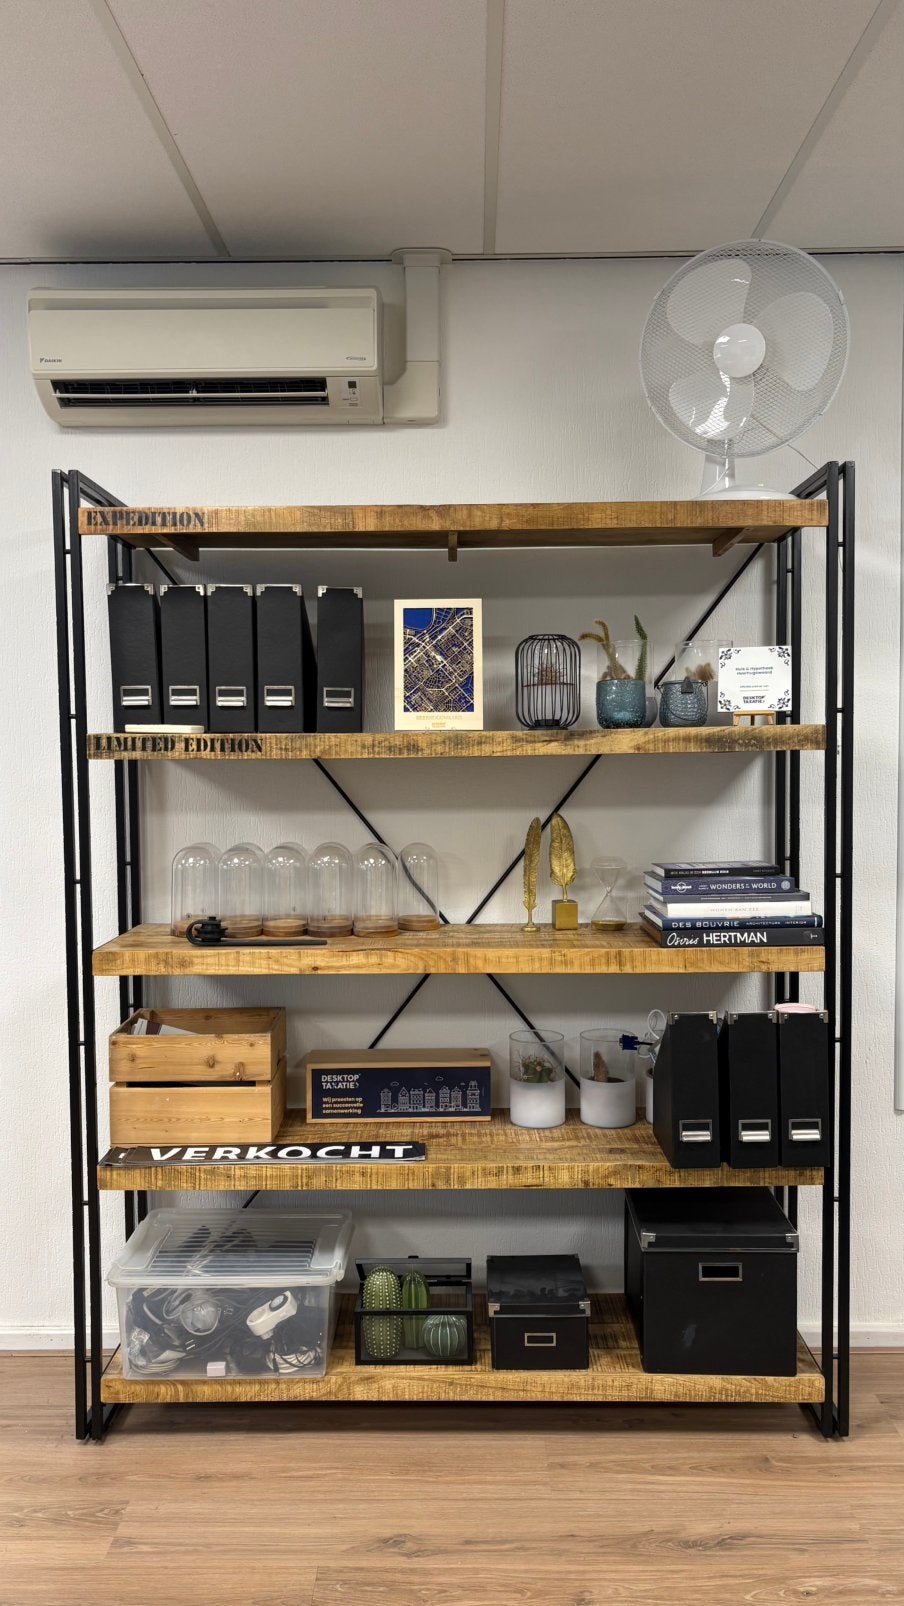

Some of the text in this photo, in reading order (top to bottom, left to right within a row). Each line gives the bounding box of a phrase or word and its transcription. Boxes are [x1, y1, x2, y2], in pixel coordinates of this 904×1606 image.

[86, 510, 206, 528] EXPEDITION
[94, 736, 263, 753] LIMITED EDITION
[666, 932, 768, 946] Osiris HERTMAN
[150, 1144, 412, 1161] VERKOCHT
